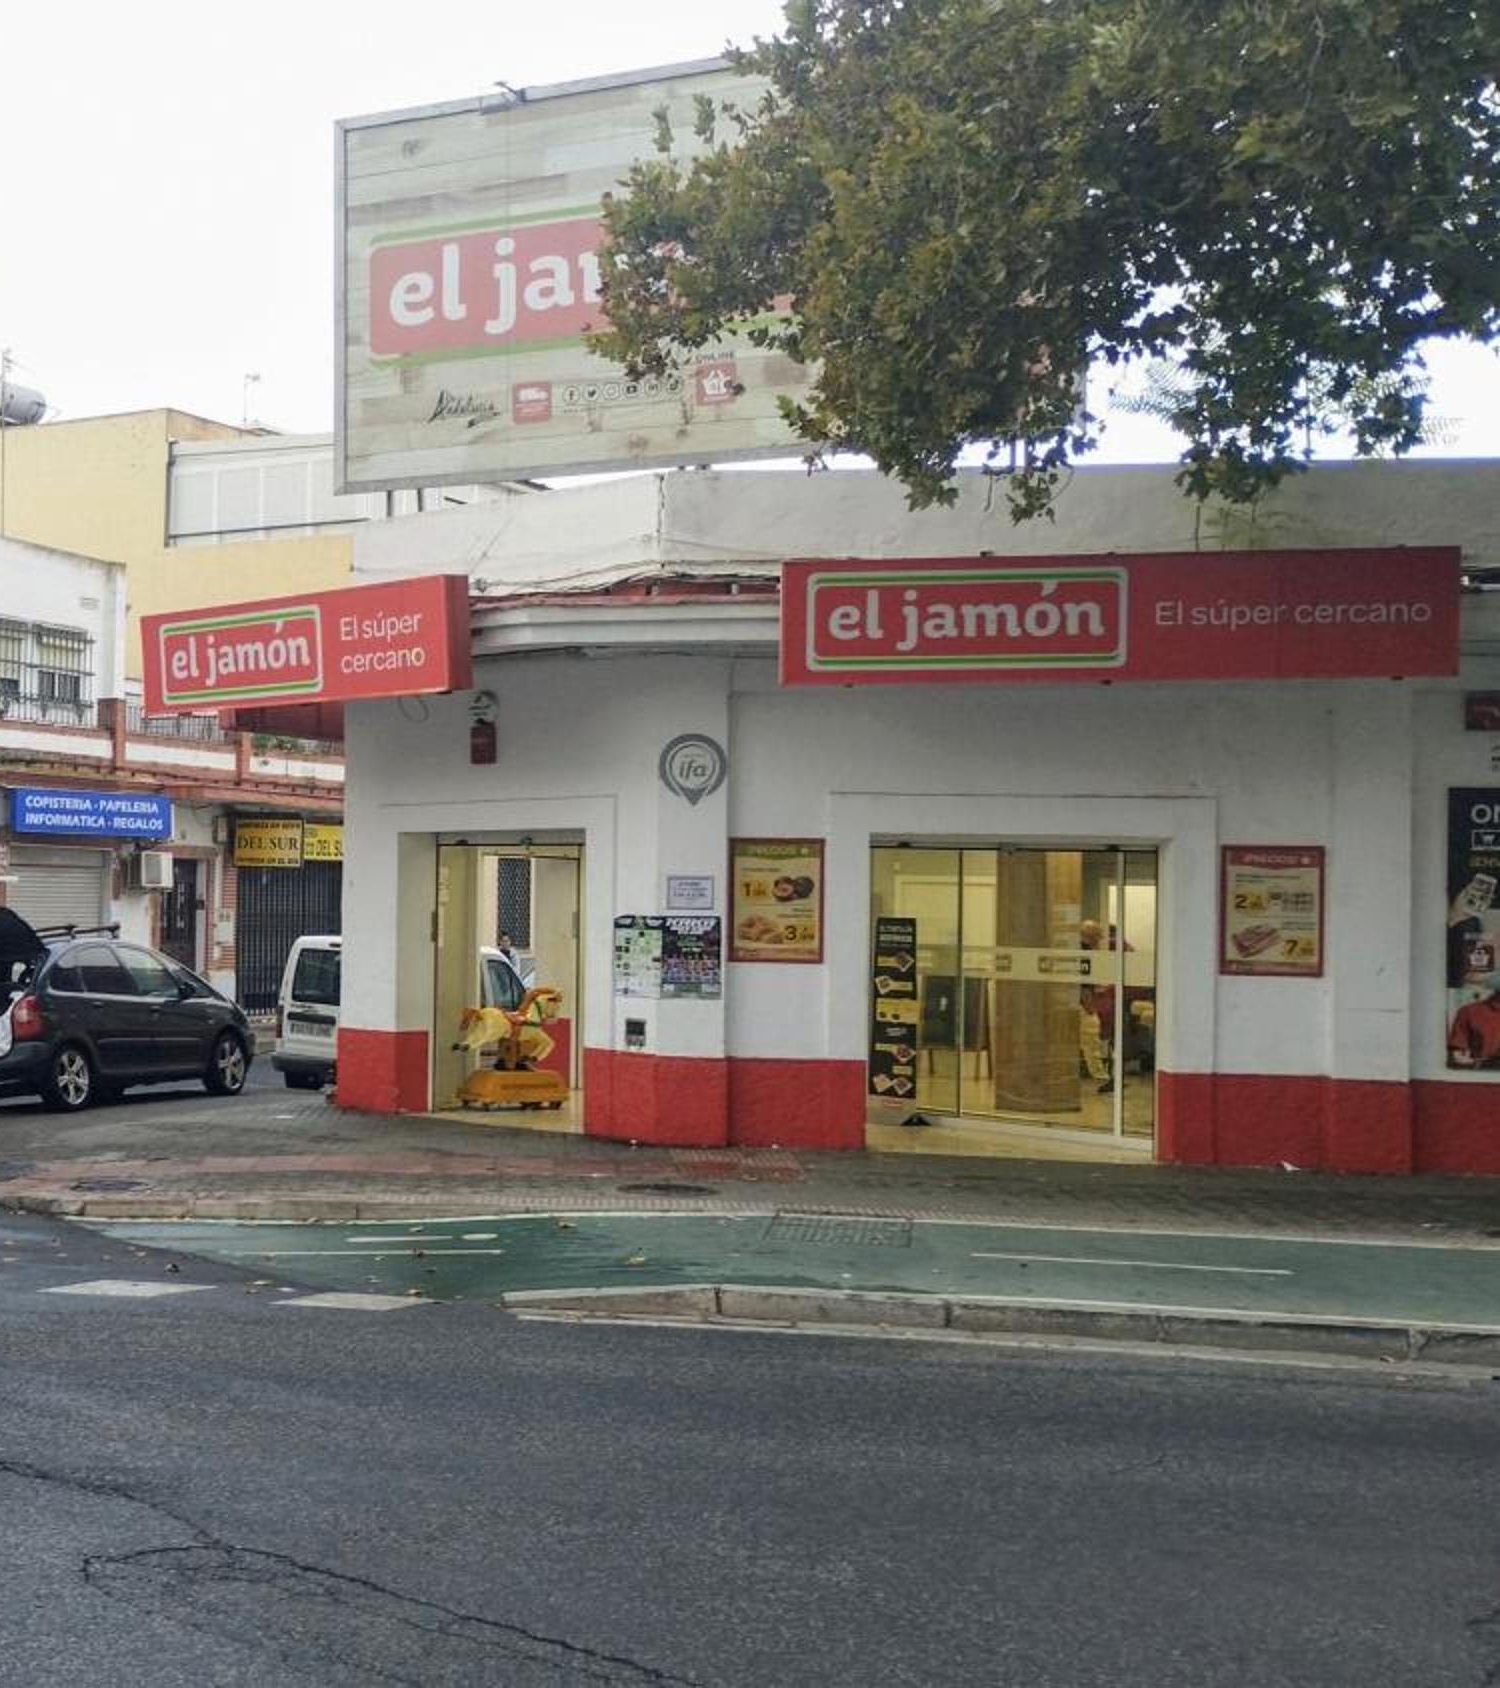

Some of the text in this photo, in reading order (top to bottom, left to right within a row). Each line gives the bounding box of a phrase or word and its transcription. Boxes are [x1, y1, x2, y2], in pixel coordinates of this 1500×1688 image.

[389, 242, 467, 326] el
[340, 612, 423, 642] El súper
[828, 579, 1105, 650] el jamón
[1155, 599, 1432, 631] El súper cercano
[171, 619, 311, 686] el jamón
[341, 647, 426, 673] cercano
[25, 795, 93, 811] COPISTERIA
[100, 800, 159, 814] PAPELERIA
[25, 813, 106, 829] INFORMATICA
[113, 817, 164, 831] REGALOS
[238, 836, 266, 849] DEL
[269, 836, 299, 850] SUR
